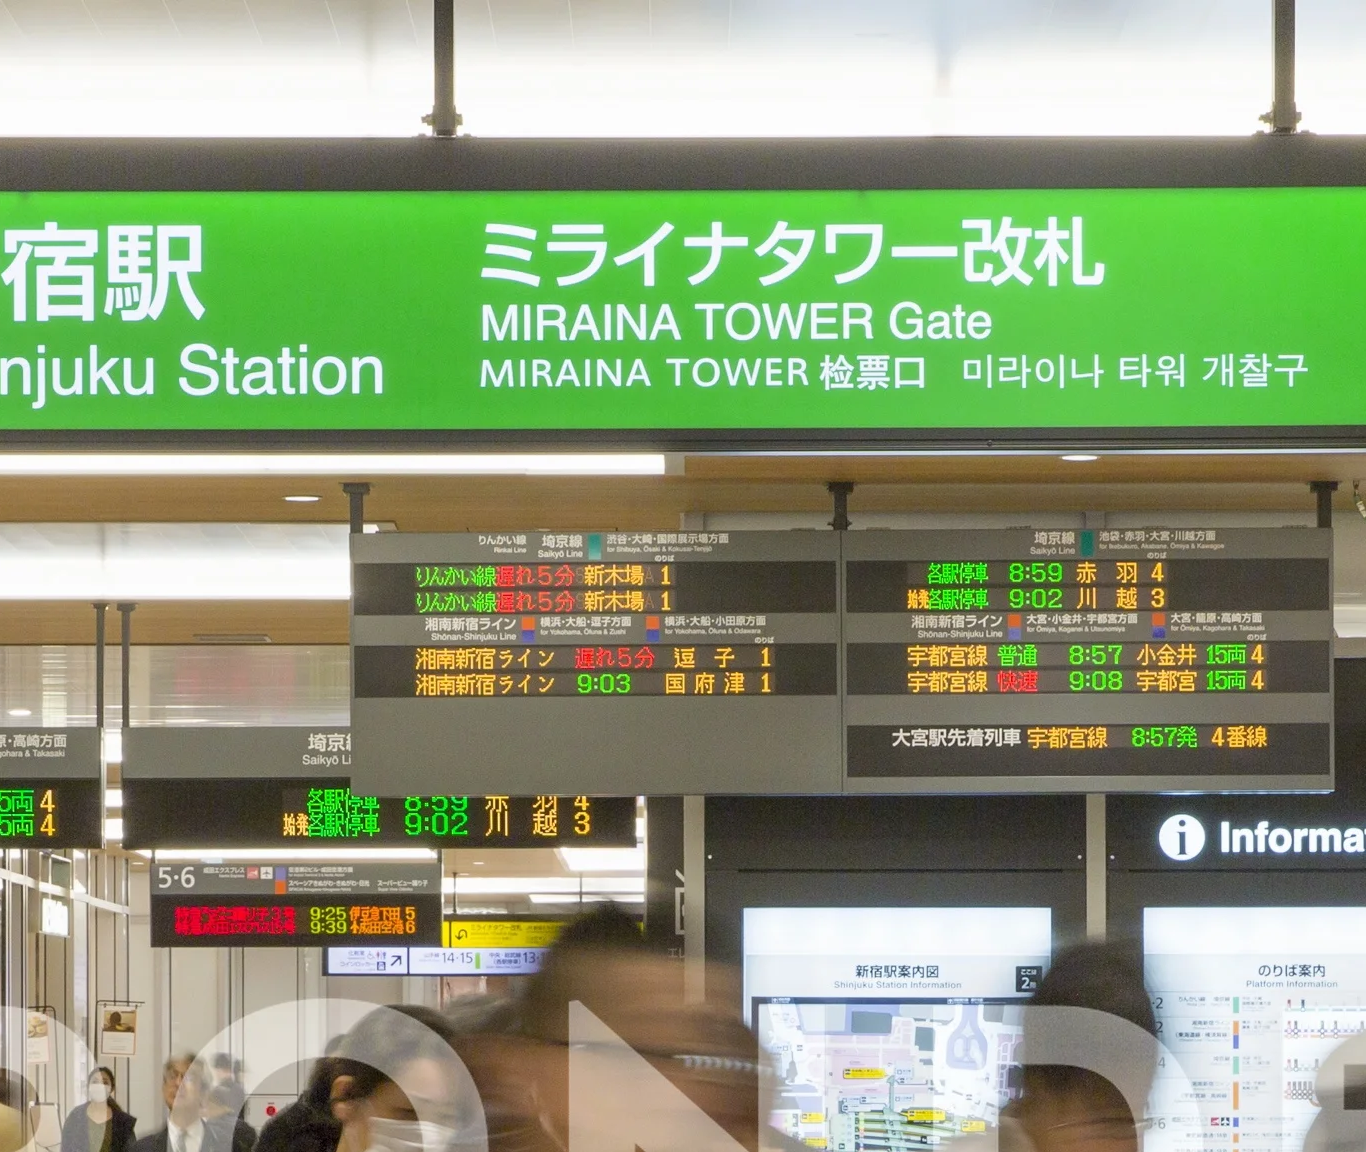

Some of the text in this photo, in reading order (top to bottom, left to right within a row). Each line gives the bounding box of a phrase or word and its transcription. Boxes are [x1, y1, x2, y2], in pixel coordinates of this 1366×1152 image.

[480, 219, 1105, 288] ミライナタワー改札
[481, 302, 992, 342] MIRAINA TOWER Gate
[178, 343, 383, 396] Station
[480, 351, 1310, 391] MIRAINA TOWER 检票口 미라이나 타워 개찰구
[478, 535, 527, 545] りんかい線
[542, 535, 583, 548] 埼京線
[1034, 531, 1075, 545] 埼京線
[584, 565, 644, 586] 新木場
[661, 566, 671, 585] 1
[927, 563, 1164, 584] 各駅停車 8:59 4
[584, 591, 671, 611] 新木場 1
[1009, 589, 1165, 608] 9:02 3
[425, 617, 516, 631] 湘南新宿ライン
[911, 615, 1003, 629] 湘南新宿ライン
[415, 647, 771, 669] 湘南新宿ライン 1
[907, 645, 1264, 667] 宇都宮線 普通 8:57 小金井 4
[415, 673, 771, 694] 湘南新宿ライン 9:03 国府津 1
[907, 671, 1264, 692] 宇都宮線 9:08 宇都宮 4
[892, 727, 1198, 749] 大宮駅先着列車 宇都宮線 8:57発
[40, 789, 55, 812] 4
[40, 813, 55, 836] 4
[405, 813, 590, 835] 9:02 3
[310, 907, 346, 921] 9:25
[310, 920, 347, 934] 9:39
[856, 965, 939, 978] 新宿駅案内図
[1258, 964, 1325, 977] のりば案内
[834, 981, 962, 990] Shinjuku Station Information
[1246, 980, 1338, 988] Platform Information
